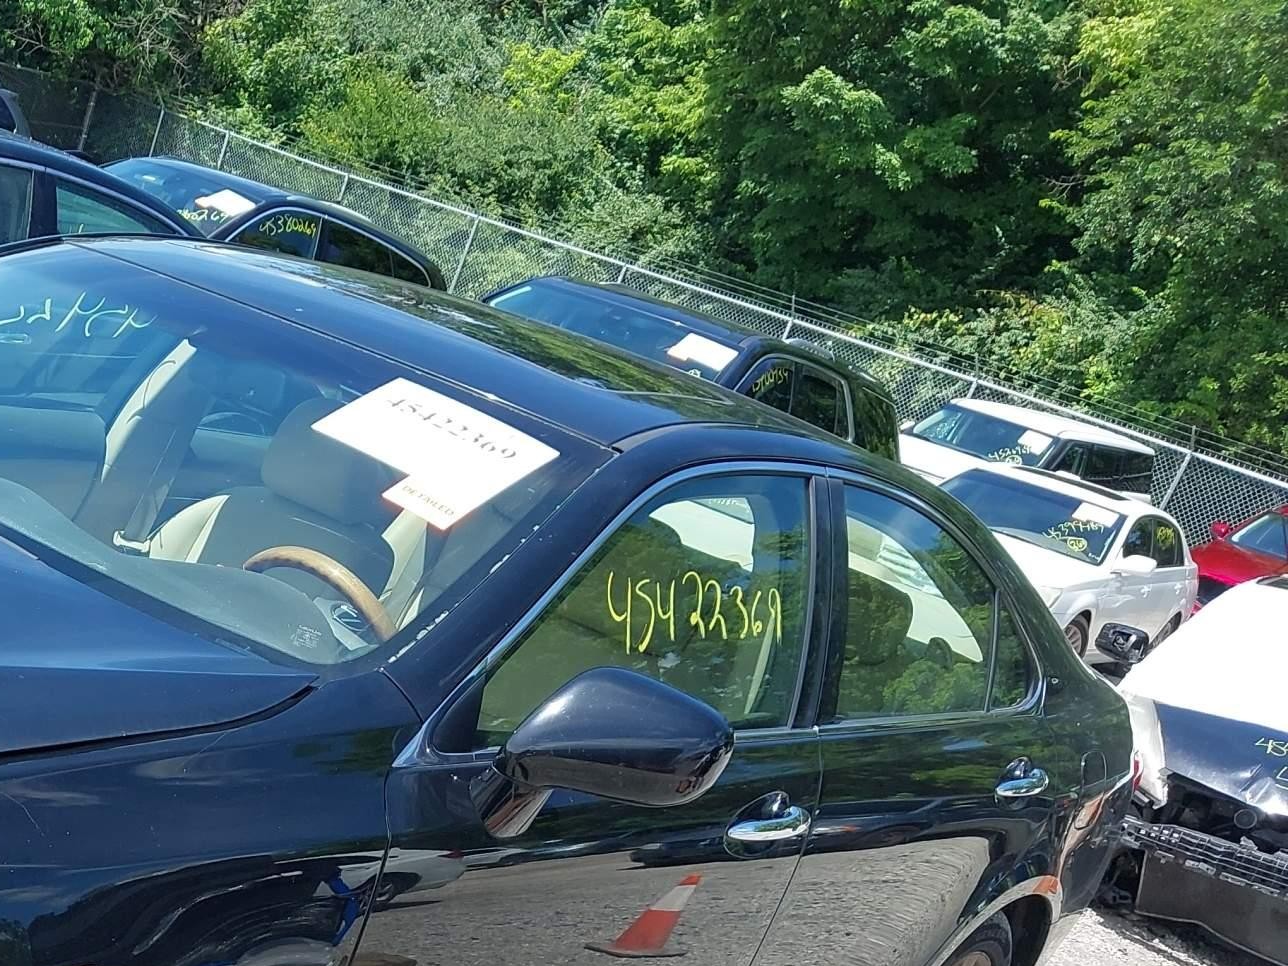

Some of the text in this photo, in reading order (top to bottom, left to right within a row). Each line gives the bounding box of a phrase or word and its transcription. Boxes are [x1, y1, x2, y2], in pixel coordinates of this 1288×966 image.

[386, 398, 518, 460] 45422369
[400, 484, 456, 518] DETAILED
[608, 571, 782, 655] 45422369
